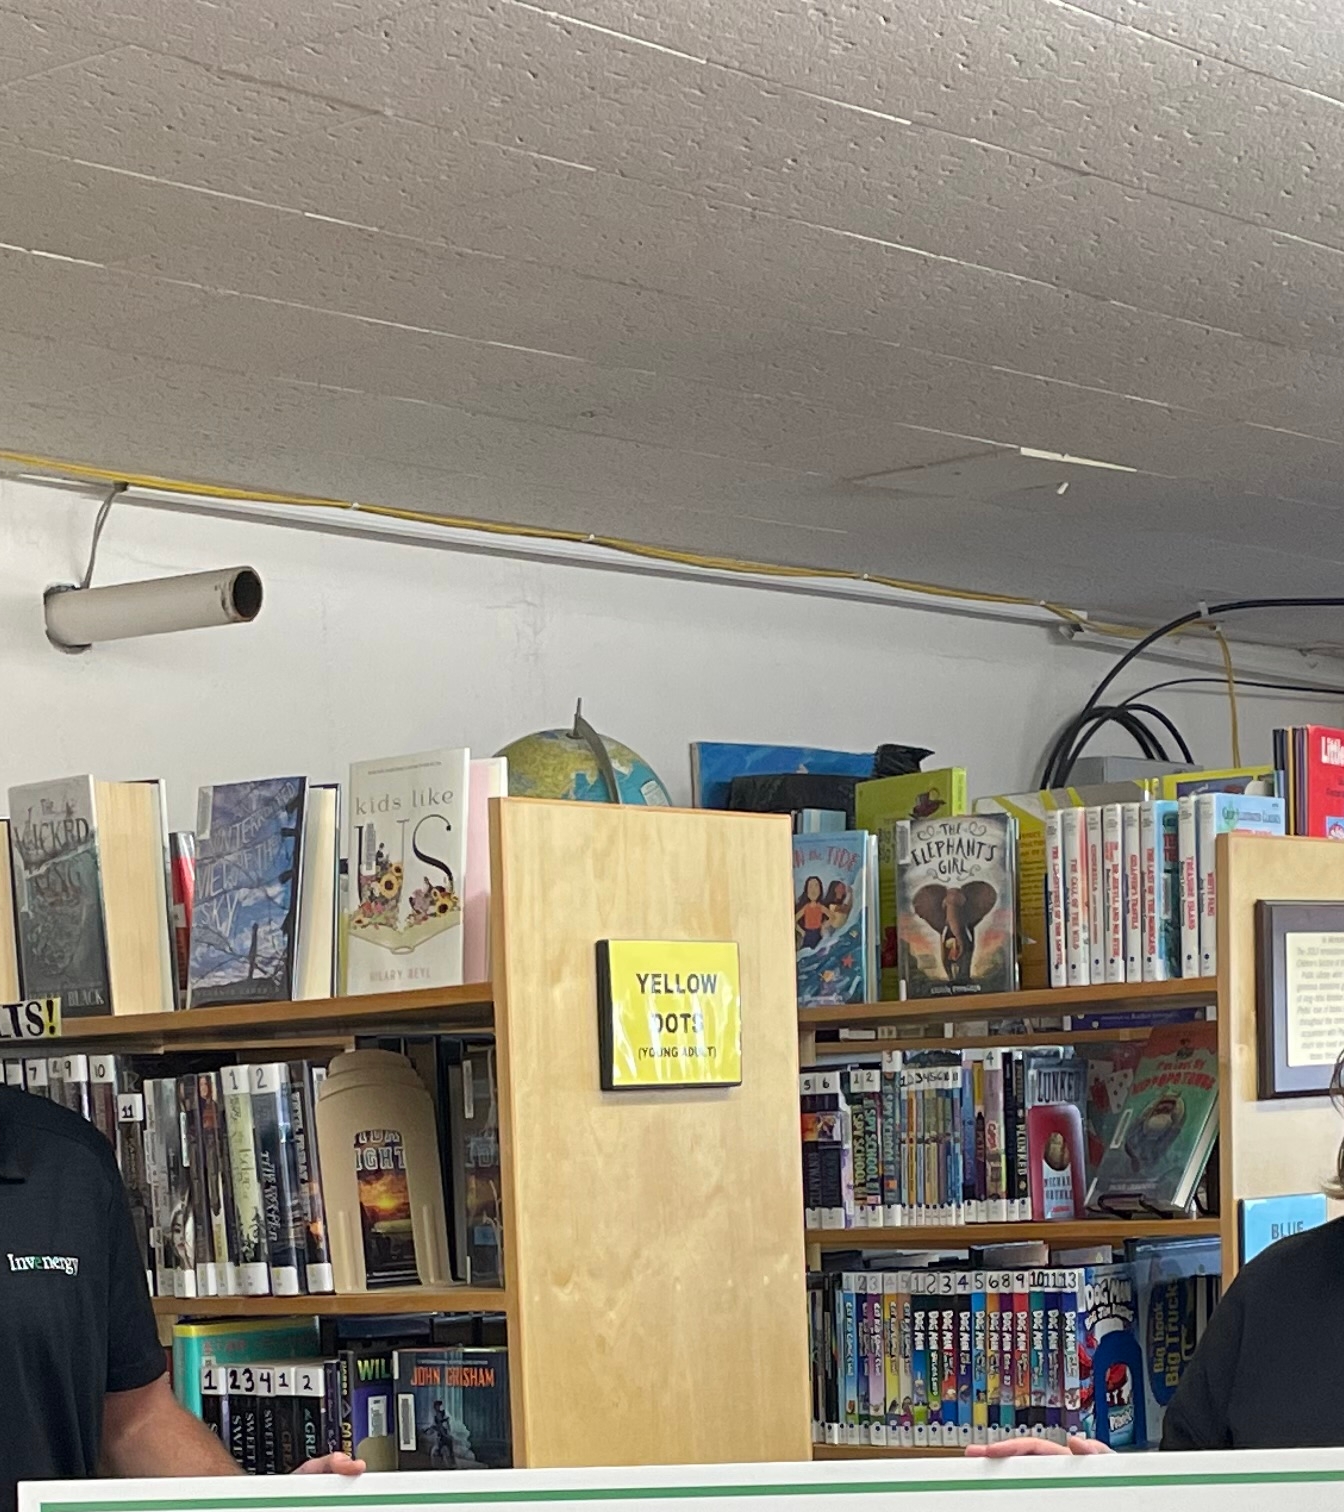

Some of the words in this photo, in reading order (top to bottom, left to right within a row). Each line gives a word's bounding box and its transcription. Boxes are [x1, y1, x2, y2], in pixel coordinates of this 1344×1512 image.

[355, 793, 402, 815] kids
[412, 787, 454, 808] like
[939, 823, 962, 836] THE
[911, 837, 999, 867] ELEPHANT'S
[938, 858, 968, 876] GIRL
[1186, 856, 1196, 898] TREASURE
[201, 892, 239, 937] SKY
[1187, 900, 1196, 930] ISLAND
[636, 973, 718, 994] YELLOW
[67, 990, 104, 1007] BLACK
[652, 1013, 703, 1033] DOTS
[867, 1108, 876, 1128] SPY
[866, 1129, 879, 1182] SCHOOL
[1016, 1124, 1028, 1176] PLUNKED
[7, 1252, 79, 1277] Invenergy
[358, 1359, 393, 1381] WIL
[410, 1367, 440, 1387] JOHN
[444, 1367, 495, 1387] GRISHAM
[264, 1410, 274, 1457] SWEET
